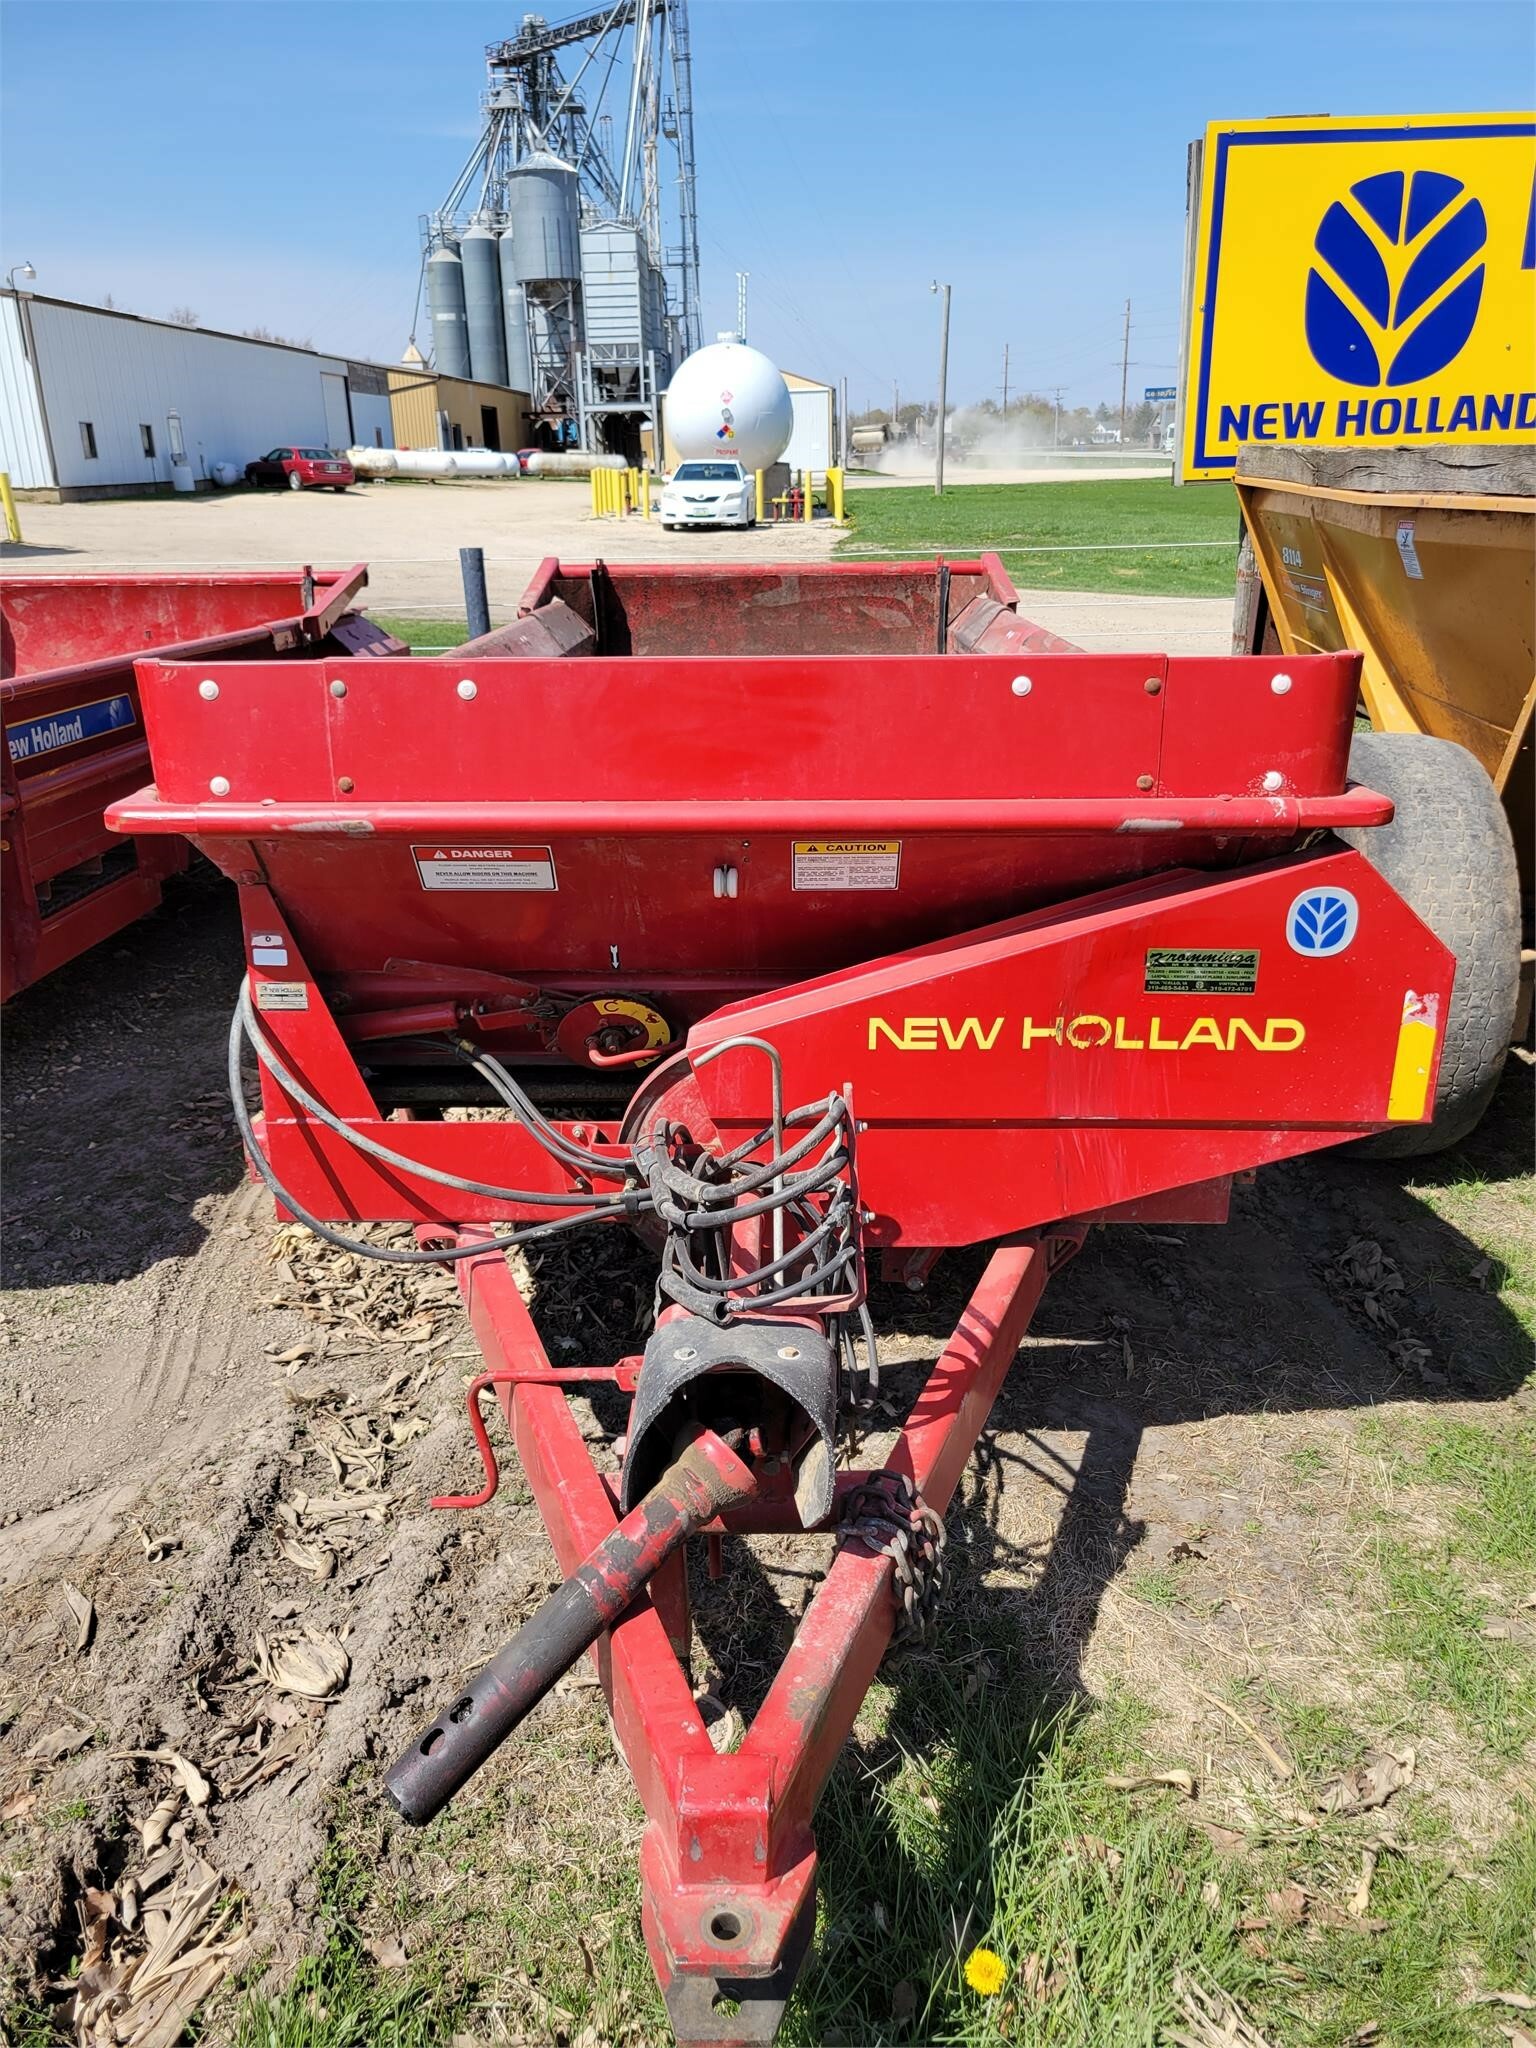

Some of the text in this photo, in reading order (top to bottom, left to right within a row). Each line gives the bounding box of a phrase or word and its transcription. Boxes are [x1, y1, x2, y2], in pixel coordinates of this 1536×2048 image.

[1218, 392, 1536, 442] NEW HOLLAND
[1282, 546, 1303, 568] 8114
[8, 714, 84, 760] ew Holland
[451, 850, 513, 858] DANGER
[826, 844, 887, 852] CAUTION
[1149, 951, 1257, 967] Kromminga
[868, 1016, 1306, 1051] NEW HOLLAND
